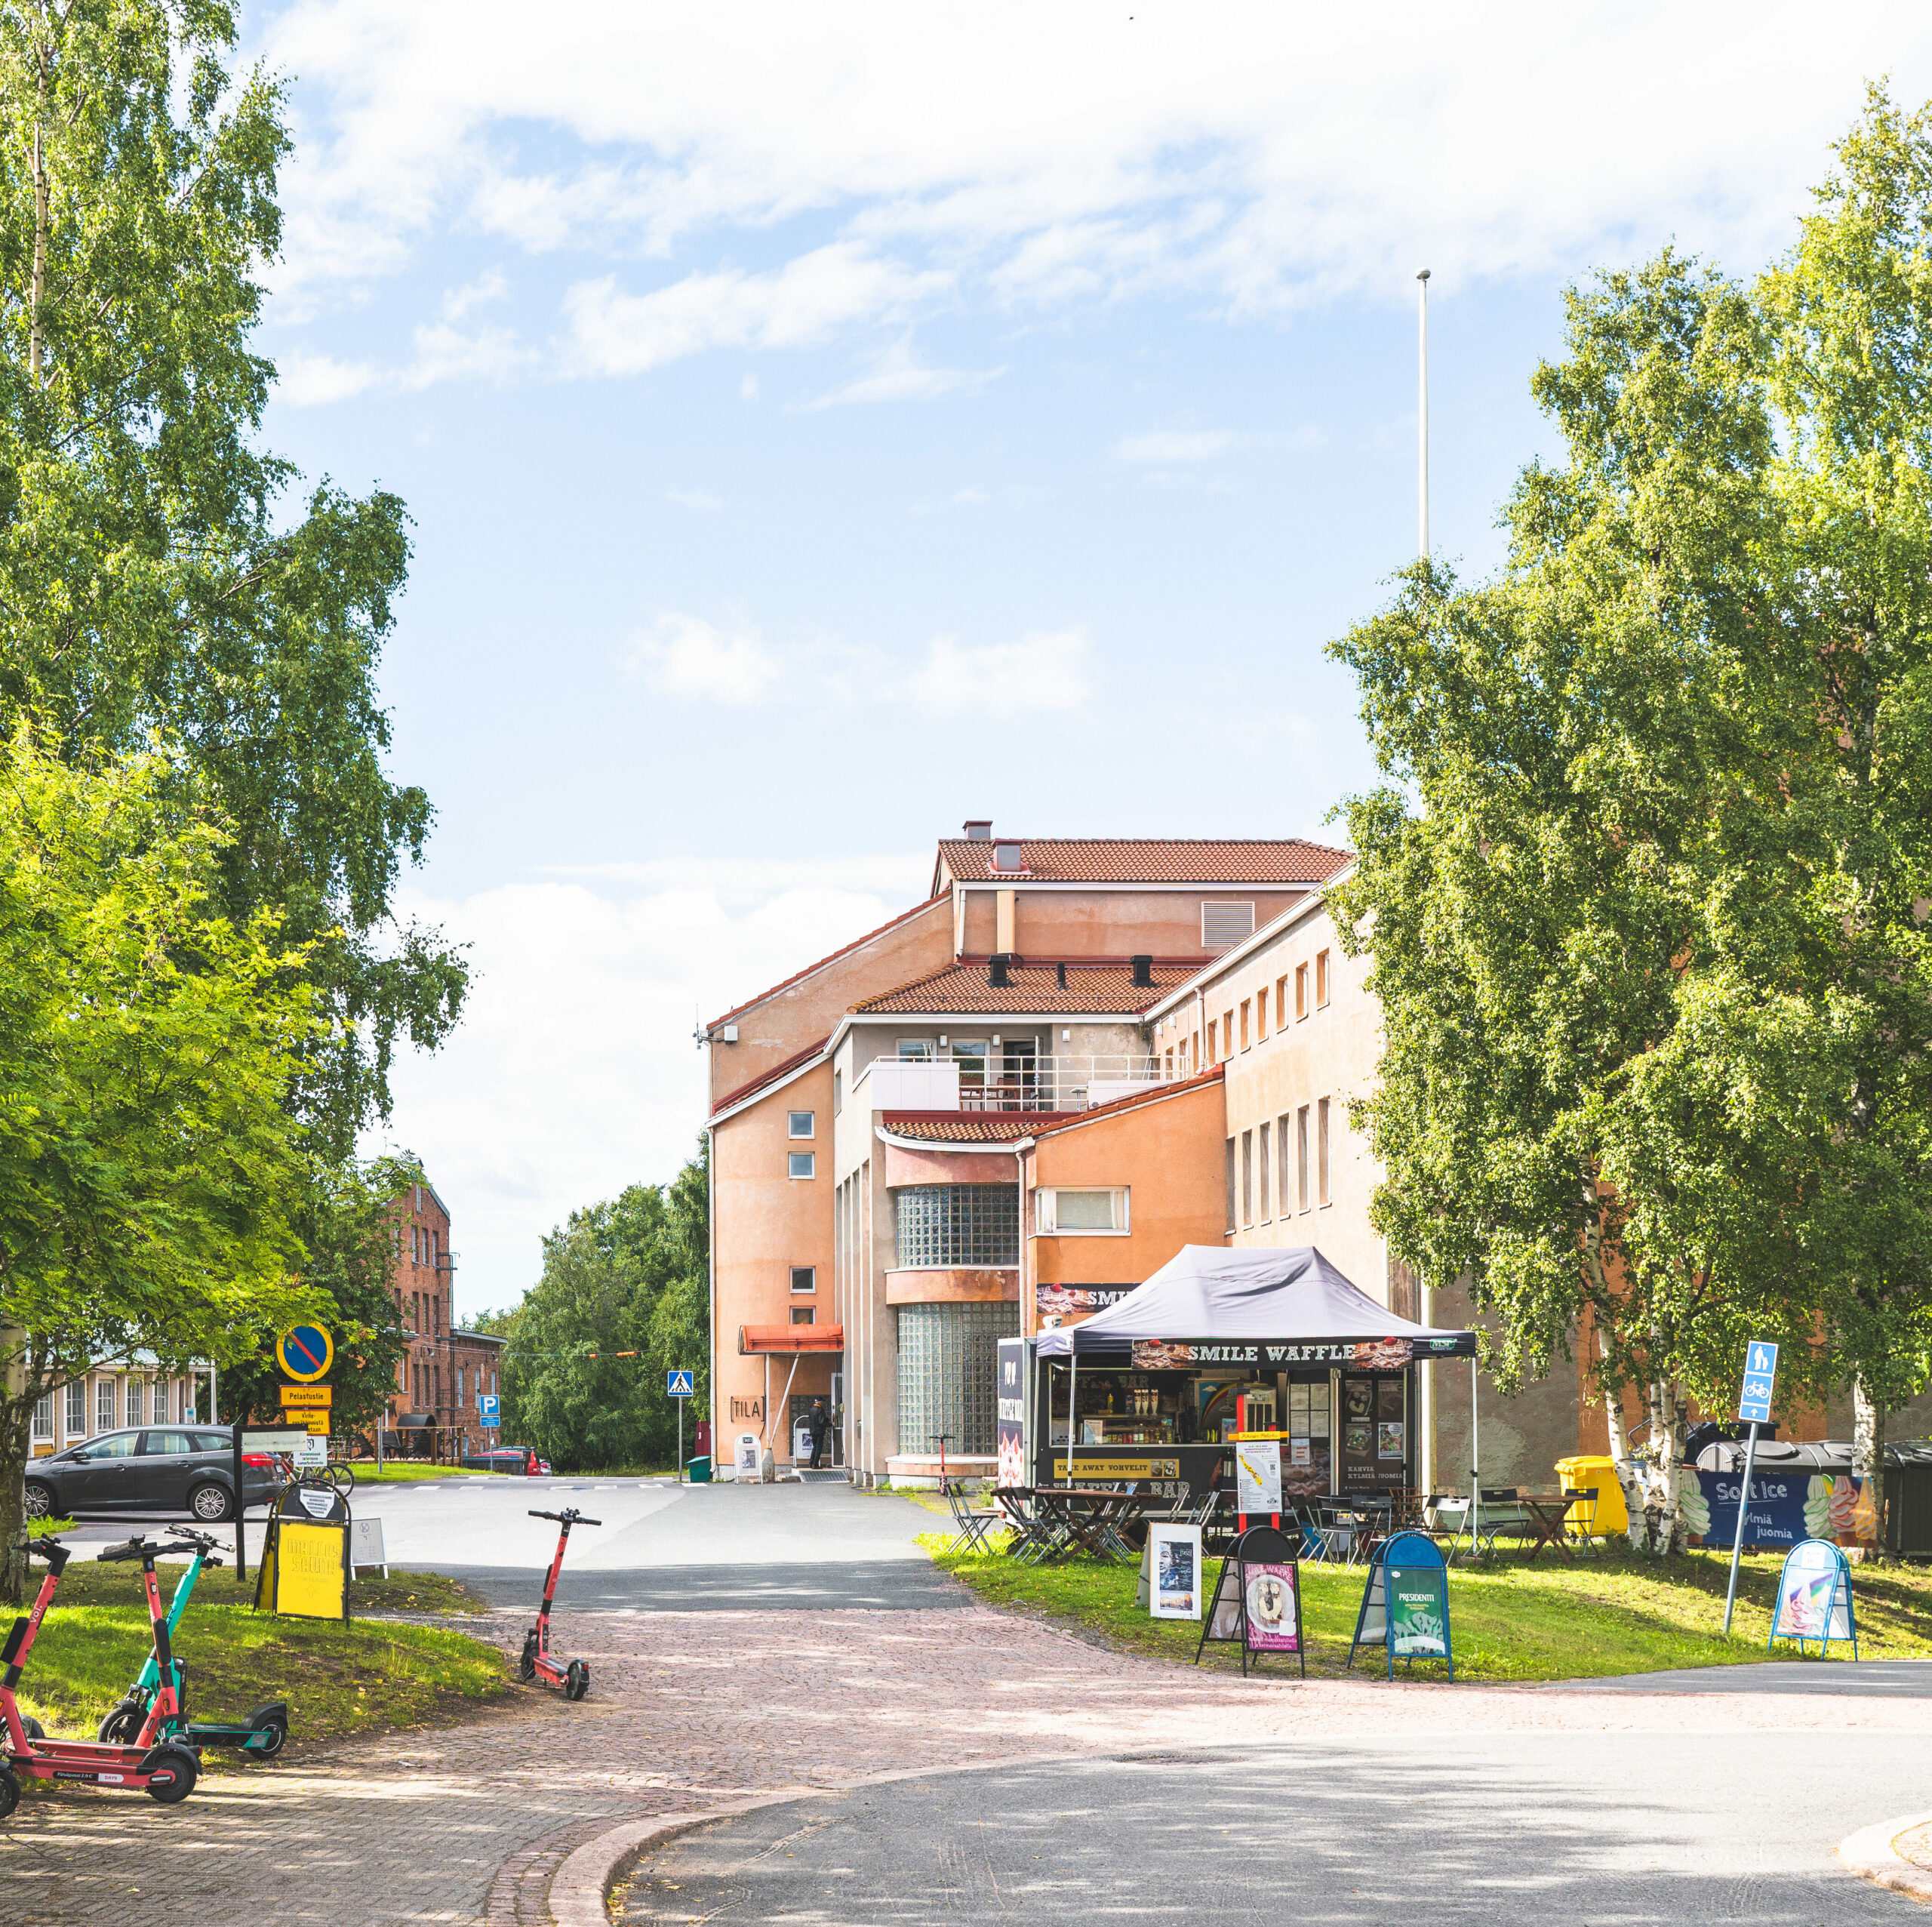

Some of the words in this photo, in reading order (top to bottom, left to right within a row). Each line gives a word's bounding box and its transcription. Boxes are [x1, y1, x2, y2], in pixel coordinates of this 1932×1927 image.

[1088, 1291, 1131, 1305] SMI
[1188, 1346, 1258, 1362] SMILE
[1266, 1344, 1356, 1361] WAFFLE
[1118, 1374, 1149, 1389] BAR
[289, 1392, 324, 1400] Pelastustie
[484, 1396, 496, 1414] P
[1715, 1482, 1758, 1501] Sot
[1761, 1481, 1788, 1499] Ice
[1738, 1512, 1773, 1525] ylmiä
[1757, 1525, 1793, 1539] juomia
[1398, 1593, 1435, 1602] PRESIDENTTI
